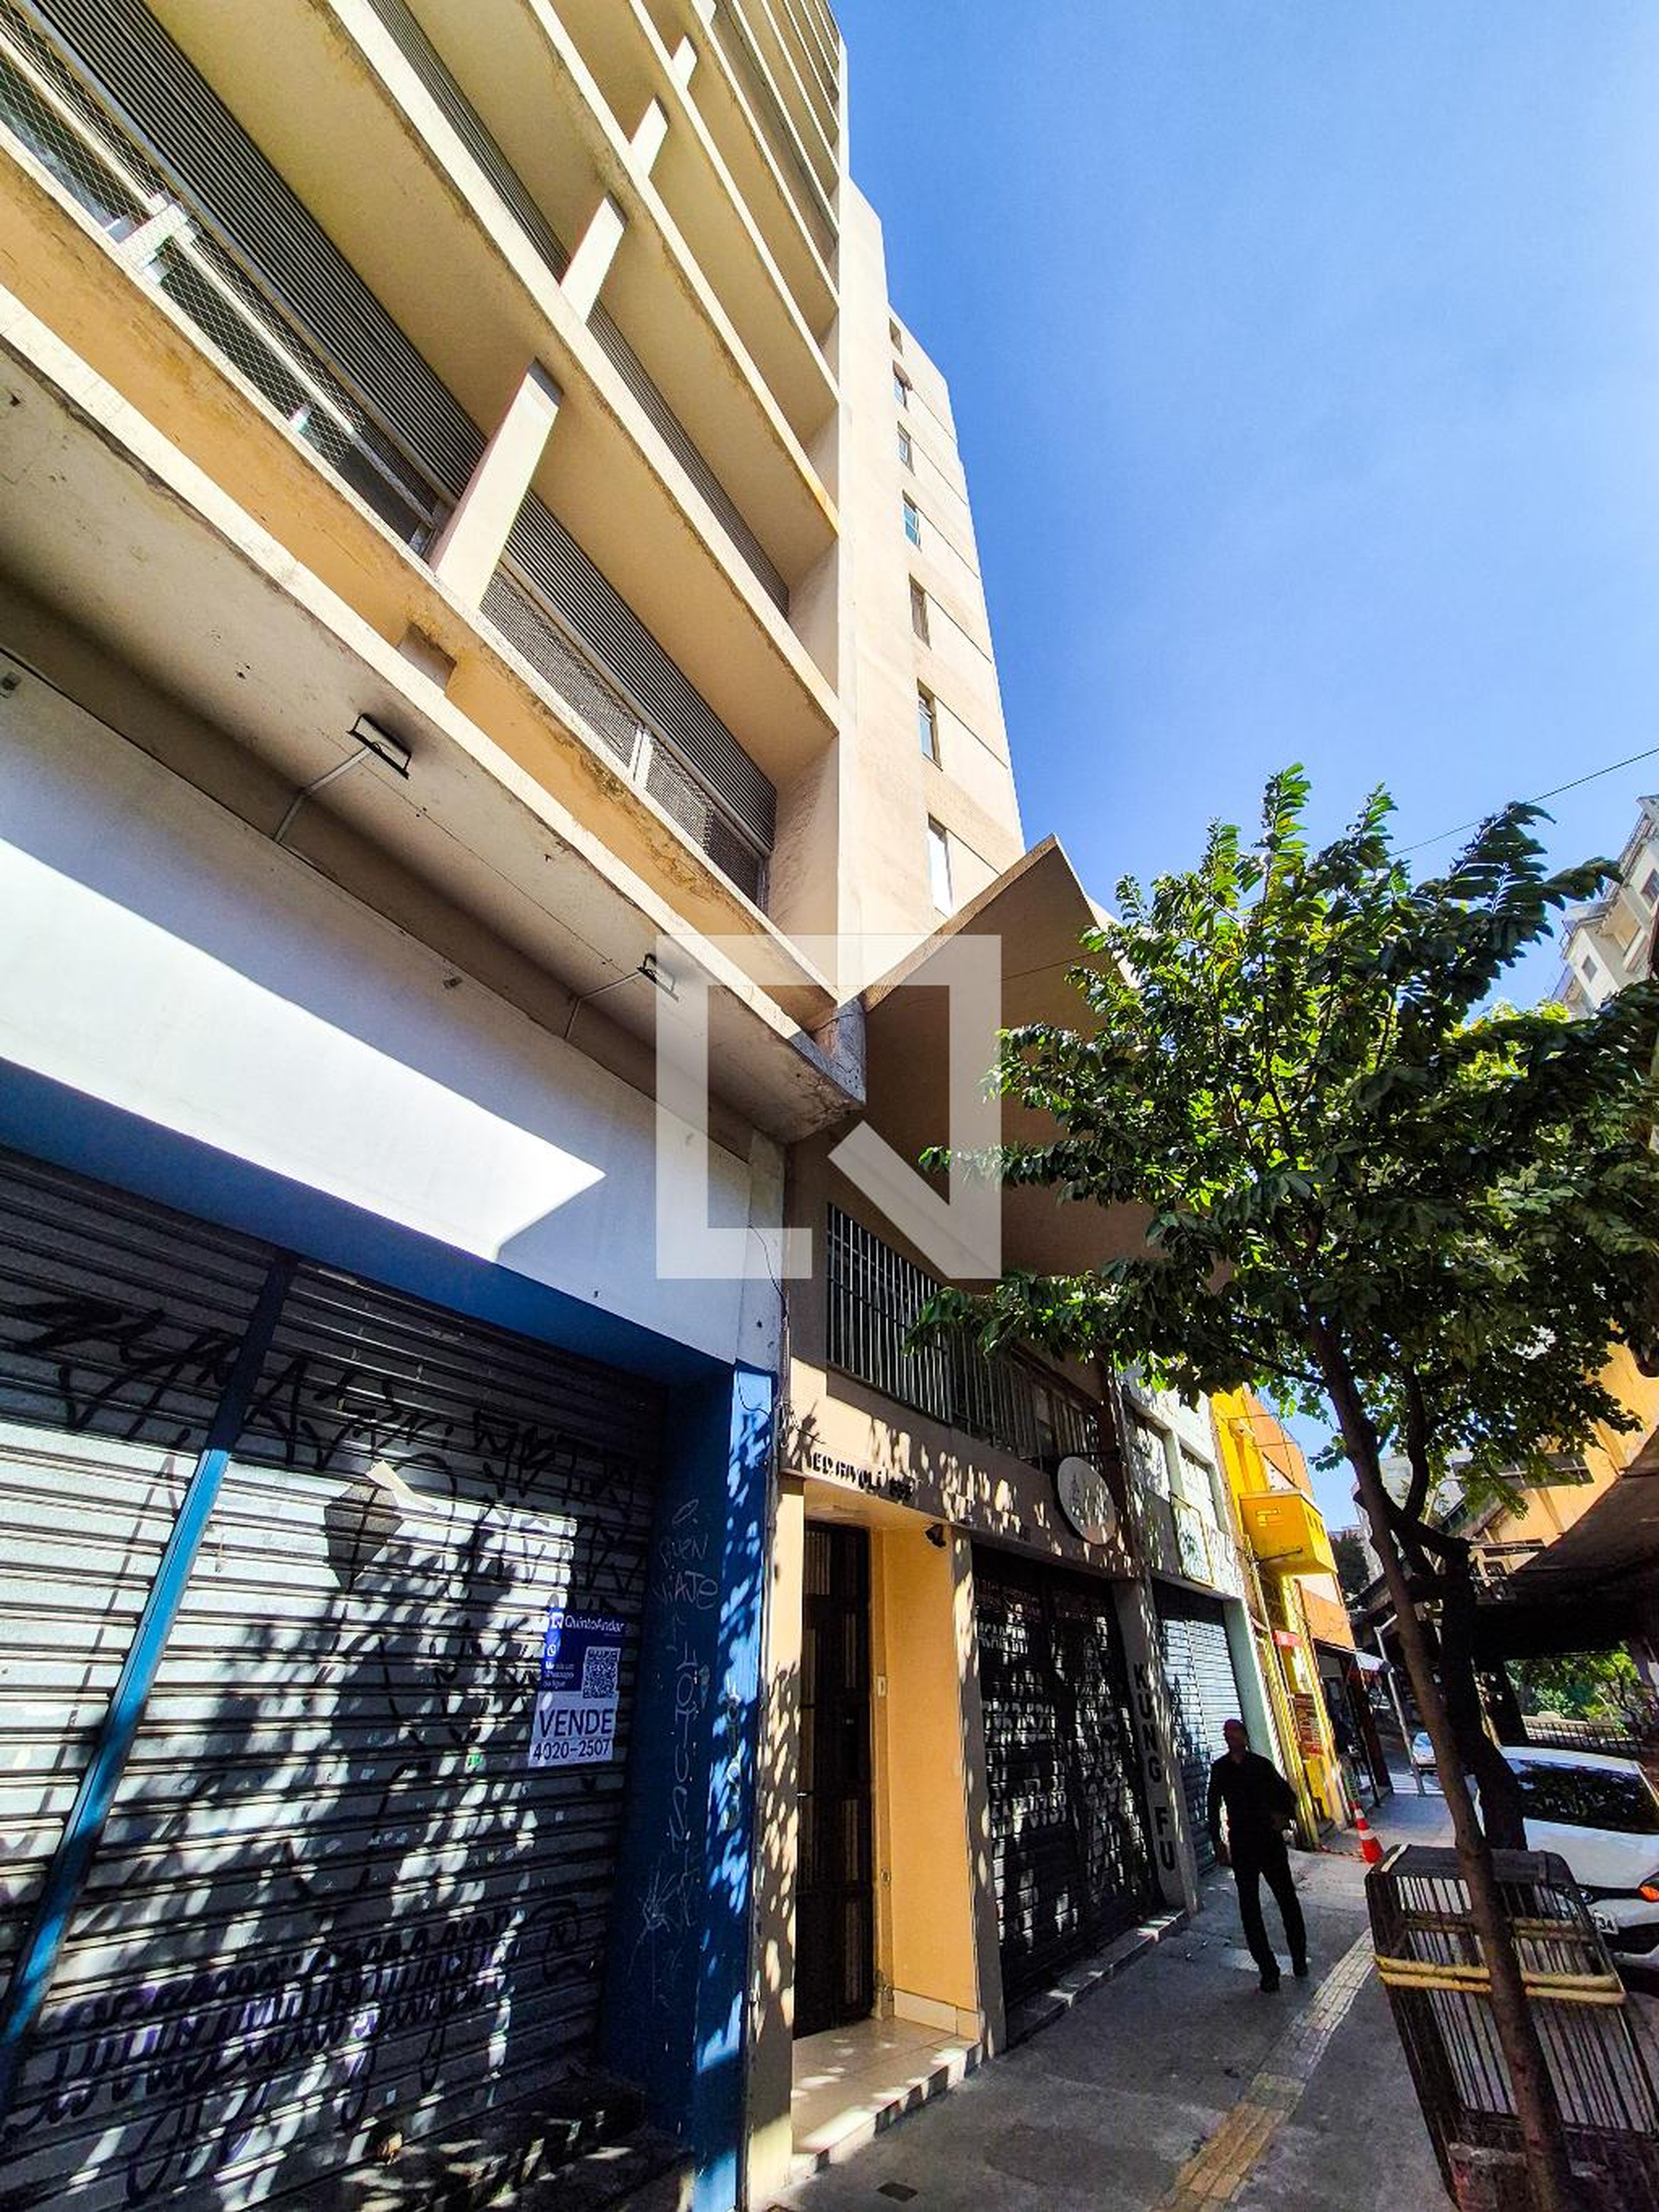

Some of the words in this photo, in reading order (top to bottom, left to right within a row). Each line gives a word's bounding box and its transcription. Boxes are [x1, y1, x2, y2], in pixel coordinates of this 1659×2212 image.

[565, 1615, 625, 1633] QuintoAndar
[540, 1709, 614, 1737] VENDE
[534, 1739, 610, 1760] 4020-2507
[1133, 1663, 1161, 1783] KUNG
[1154, 1806, 1175, 1871] FU
